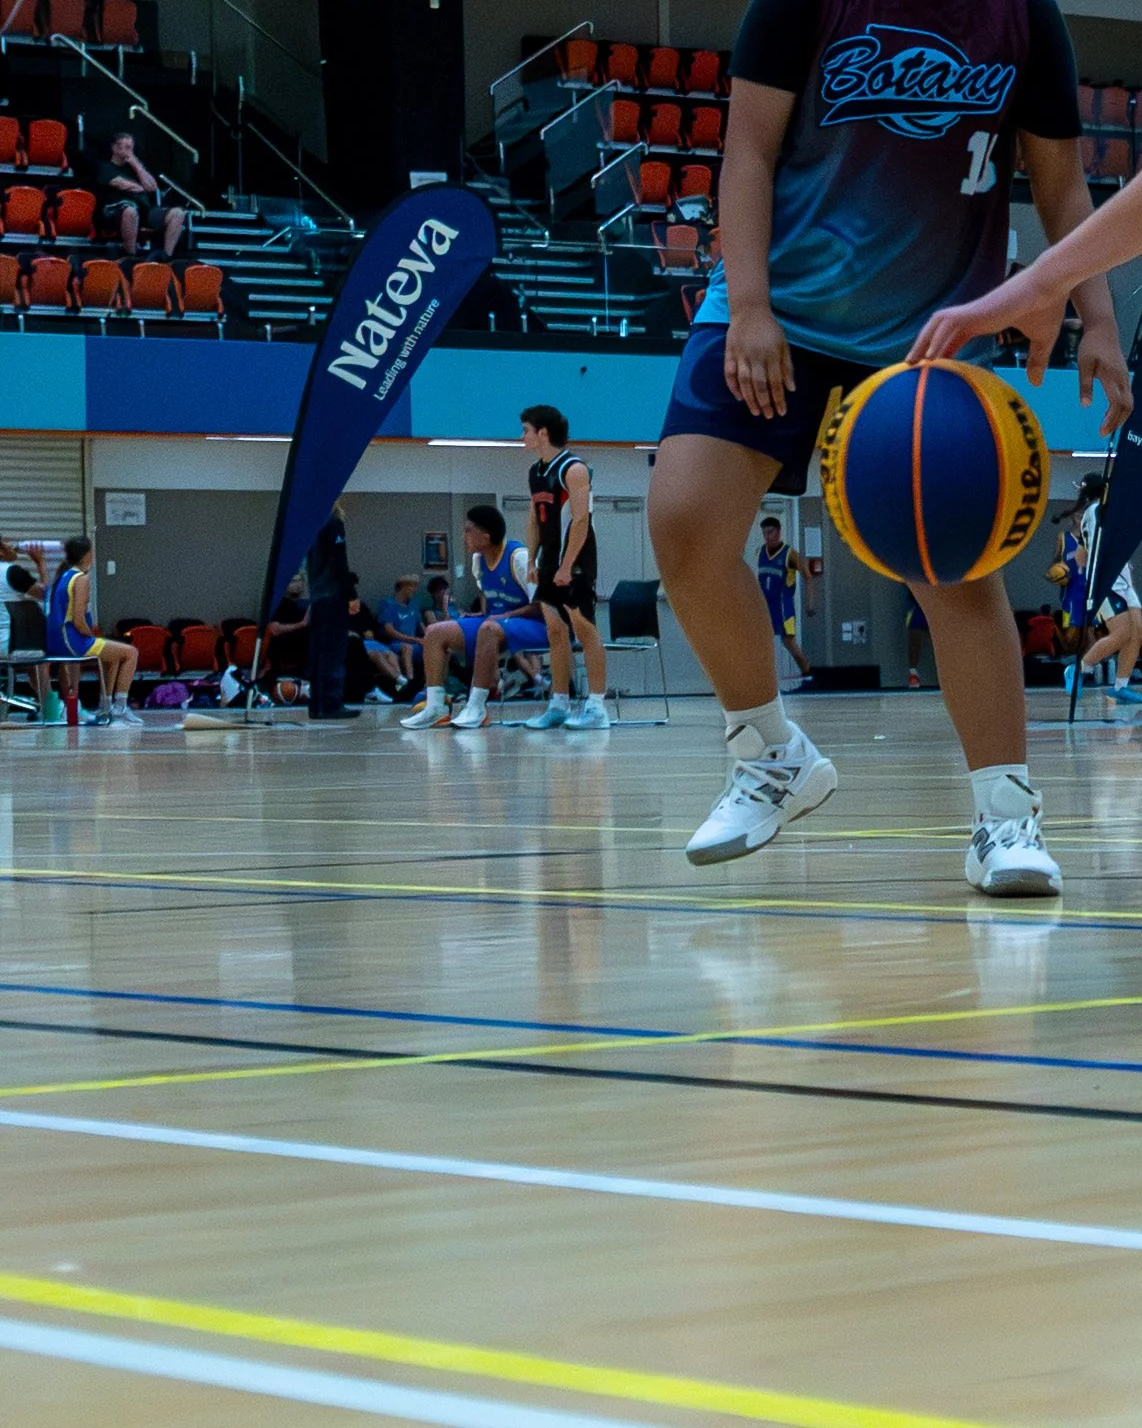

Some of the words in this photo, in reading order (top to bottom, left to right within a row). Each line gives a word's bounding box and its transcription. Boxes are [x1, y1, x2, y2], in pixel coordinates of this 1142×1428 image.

[820, 35, 1016, 120] Botany
[327, 219, 460, 390] Nateva
[373, 358, 407, 401] Leading
[400, 334, 419, 358] with
[414, 298, 440, 335] nature
